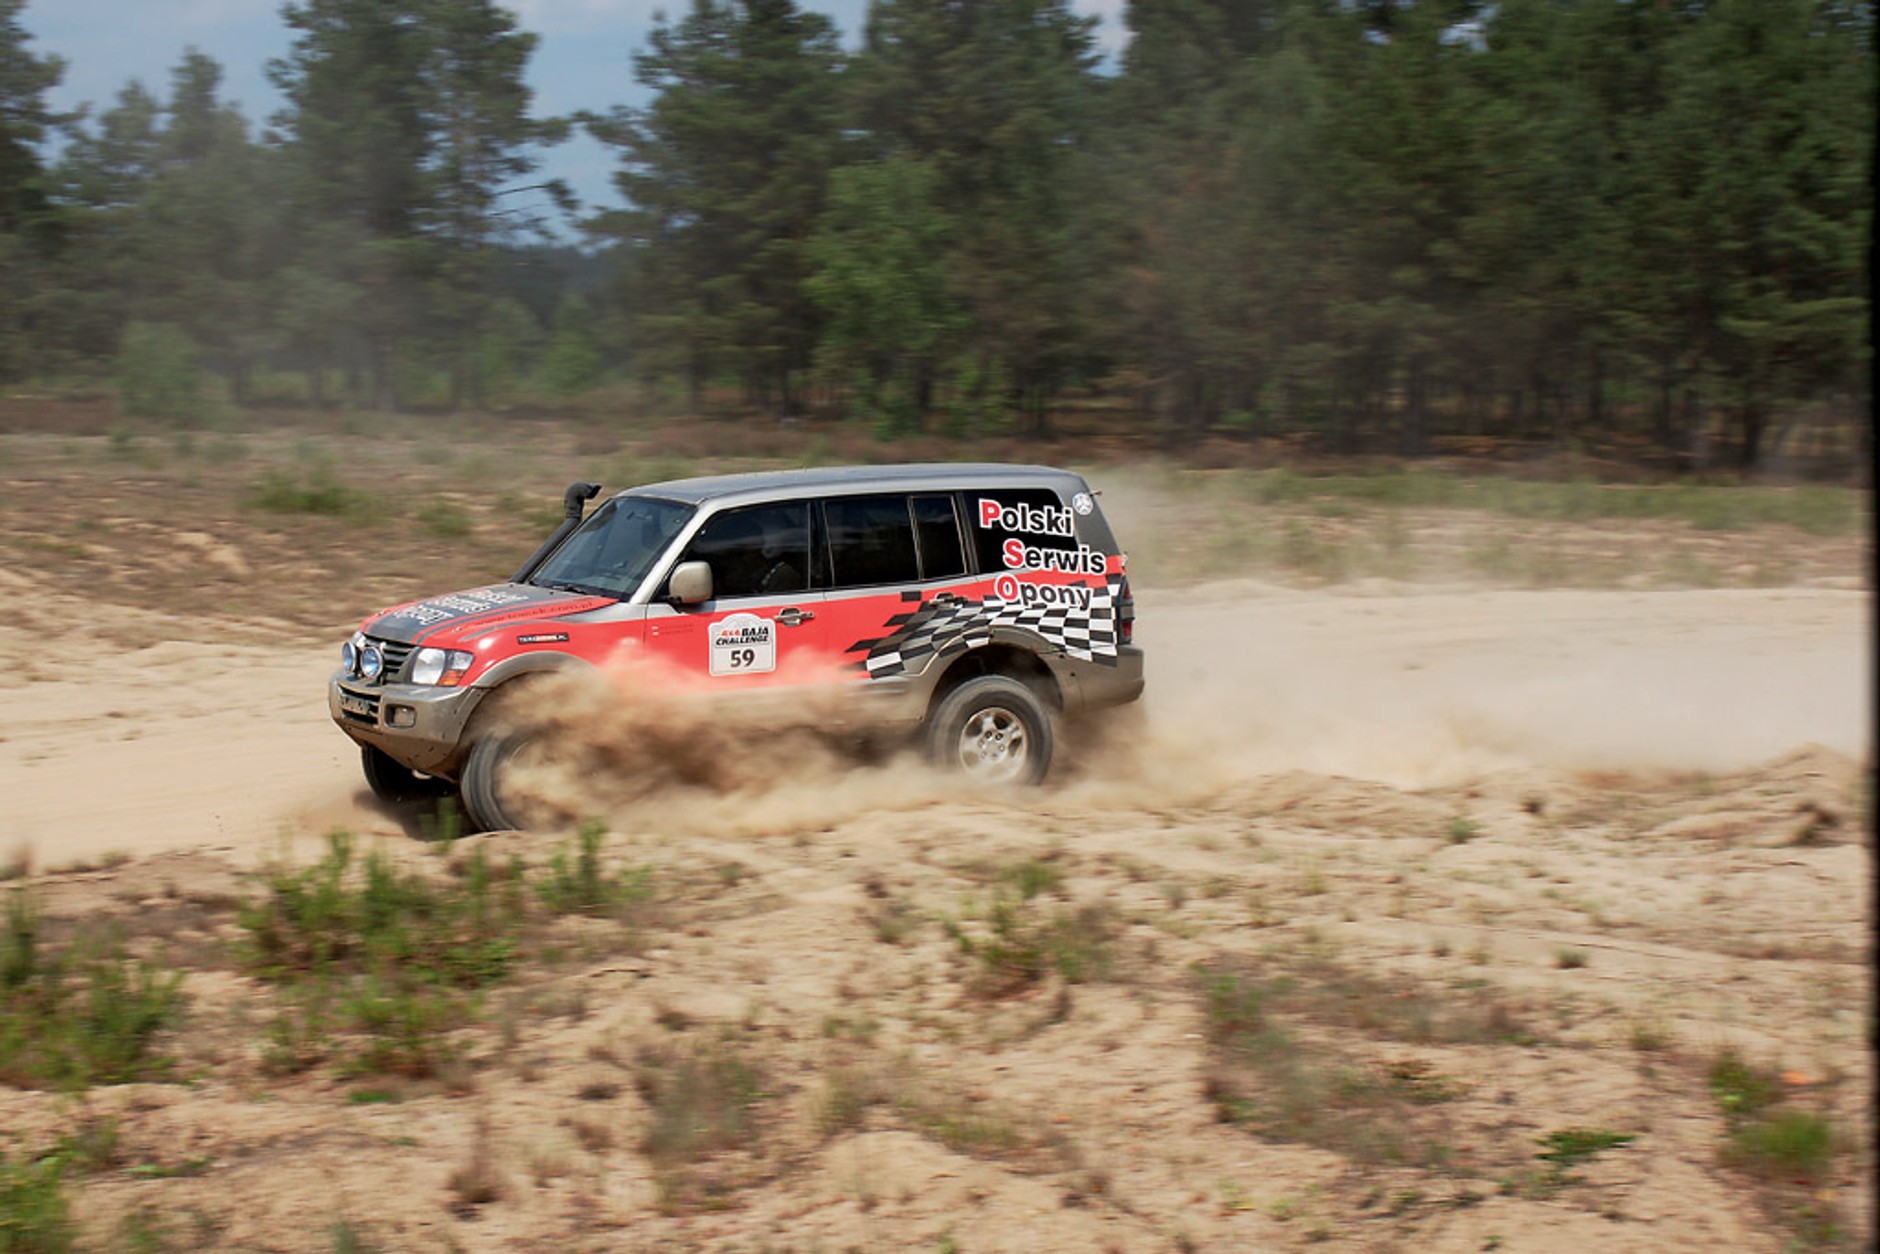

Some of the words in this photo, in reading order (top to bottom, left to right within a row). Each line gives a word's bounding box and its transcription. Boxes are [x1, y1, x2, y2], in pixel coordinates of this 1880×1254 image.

[979, 498, 1073, 537] Polski
[1003, 539, 1106, 574] Serwis
[995, 575, 1092, 611] Opony
[715, 635, 769, 646] CHALLENGE
[741, 626, 769, 637] BAJA
[730, 648, 755, 668] 59
